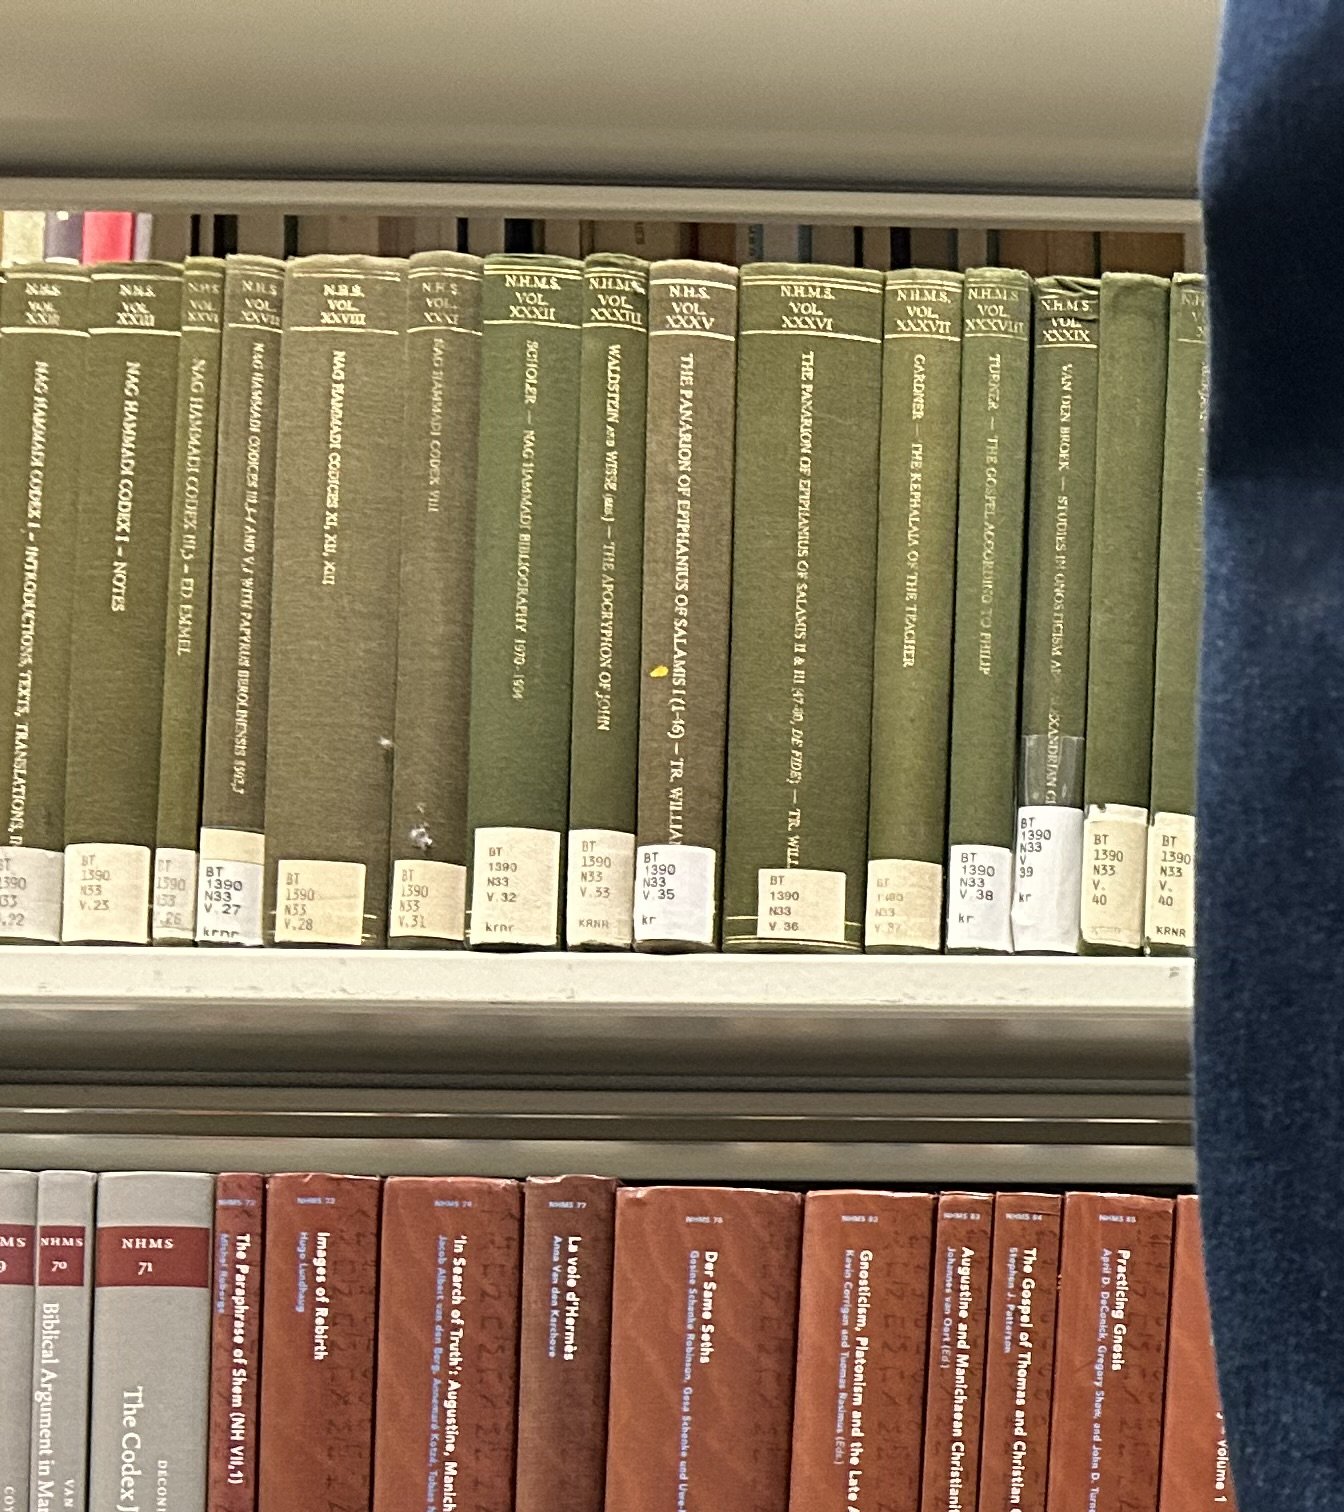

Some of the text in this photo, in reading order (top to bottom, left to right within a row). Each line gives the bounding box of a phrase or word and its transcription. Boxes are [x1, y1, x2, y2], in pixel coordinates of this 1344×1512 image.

[510, 305, 555, 320] XXXII
[666, 316, 714, 330] XXXV
[673, 353, 693, 685] THE PANARION OF EPIPHANIUS OF SALAMIS
[1162, 835, 1177, 846] BT
[1162, 851, 1191, 864] 1390
[1160, 866, 1182, 877] N33
[1156, 926, 1185, 937] KRNR
[40, 1238, 83, 1247] NHMS
[122, 1238, 173, 1248] NHMS
[236, 1234, 250, 1259] The
[568, 1237, 581, 1252] La
[52, 1260, 67, 1271] 70
[138, 1261, 152, 1275] 71
[567, 1257, 580, 1287] voie
[1024, 1248, 1037, 1273] The
[958, 1247, 974, 1318] Augustine
[232, 1264, 249, 1343] Paraphrase
[313, 1233, 330, 1359] Images of Rebirth
[700, 1252, 718, 1363] Der Same Seths
[1017, 1277, 1035, 1327] Gospel
[1111, 1249, 1130, 1370] Practicing Gnosis
[42, 1304, 60, 1363] Biblical
[957, 1323, 970, 1349] and
[1020, 1331, 1032, 1348] of
[233, 1348, 247, 1365] of
[232, 1368, 248, 1407] Shem
[1016, 1352, 1032, 1405] Thomas
[123, 1386, 144, 1427] The
[953, 1353, 969, 1436] Manichaean
[35, 1369, 58, 1455] Argument
[1015, 1410, 1027, 1436] and
[230, 1413, 245, 1440] (NH
[38, 1460, 55, 1475] in
[120, 1433, 141, 1500] Codex
[1010, 1440, 1026, 1504] Christian
